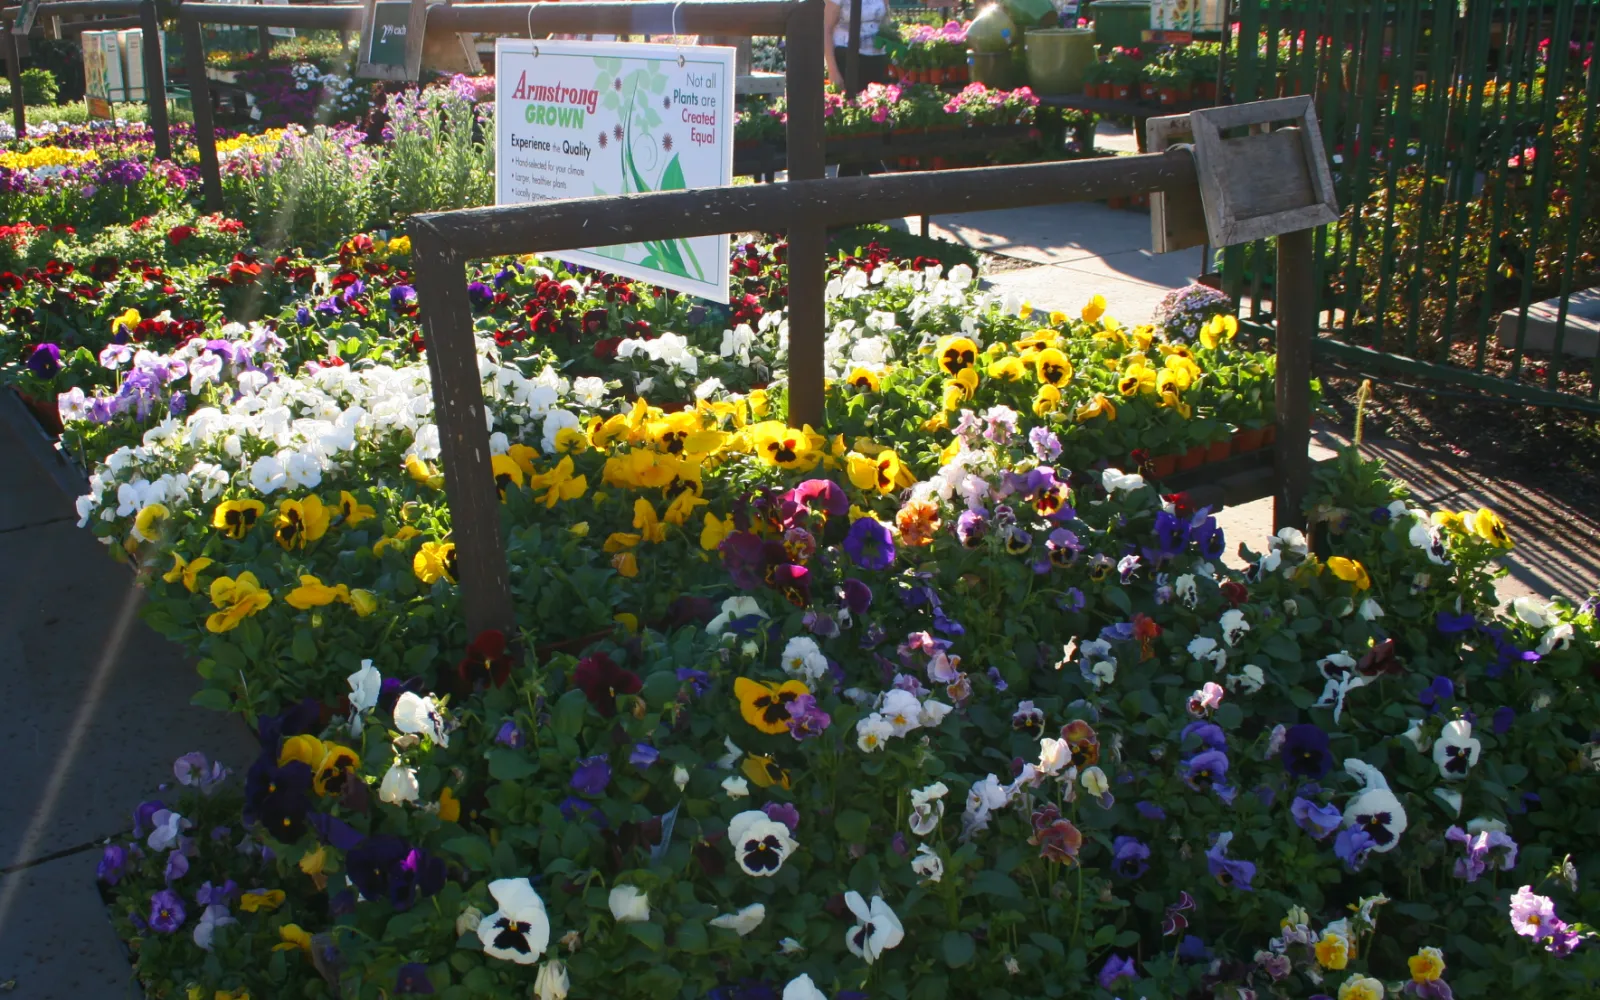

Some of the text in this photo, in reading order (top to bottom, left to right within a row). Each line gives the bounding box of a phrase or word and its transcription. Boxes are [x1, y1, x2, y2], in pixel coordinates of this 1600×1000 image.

[686, 72, 717, 88] Not all
[511, 69, 599, 115] Armstrong
[673, 88, 716, 107] Plants are
[525, 103, 585, 129] GROWN
[681, 108, 716, 126] Created
[691, 127, 716, 147] Equal
[511, 133, 591, 161] Experience the Quality
[547, 160, 555, 171] for
[555, 166, 566, 175] your
[567, 164, 585, 176] climate
[531, 173, 552, 186] healthier
[552, 178, 567, 189] plants
[515, 187, 531, 200] Locally
